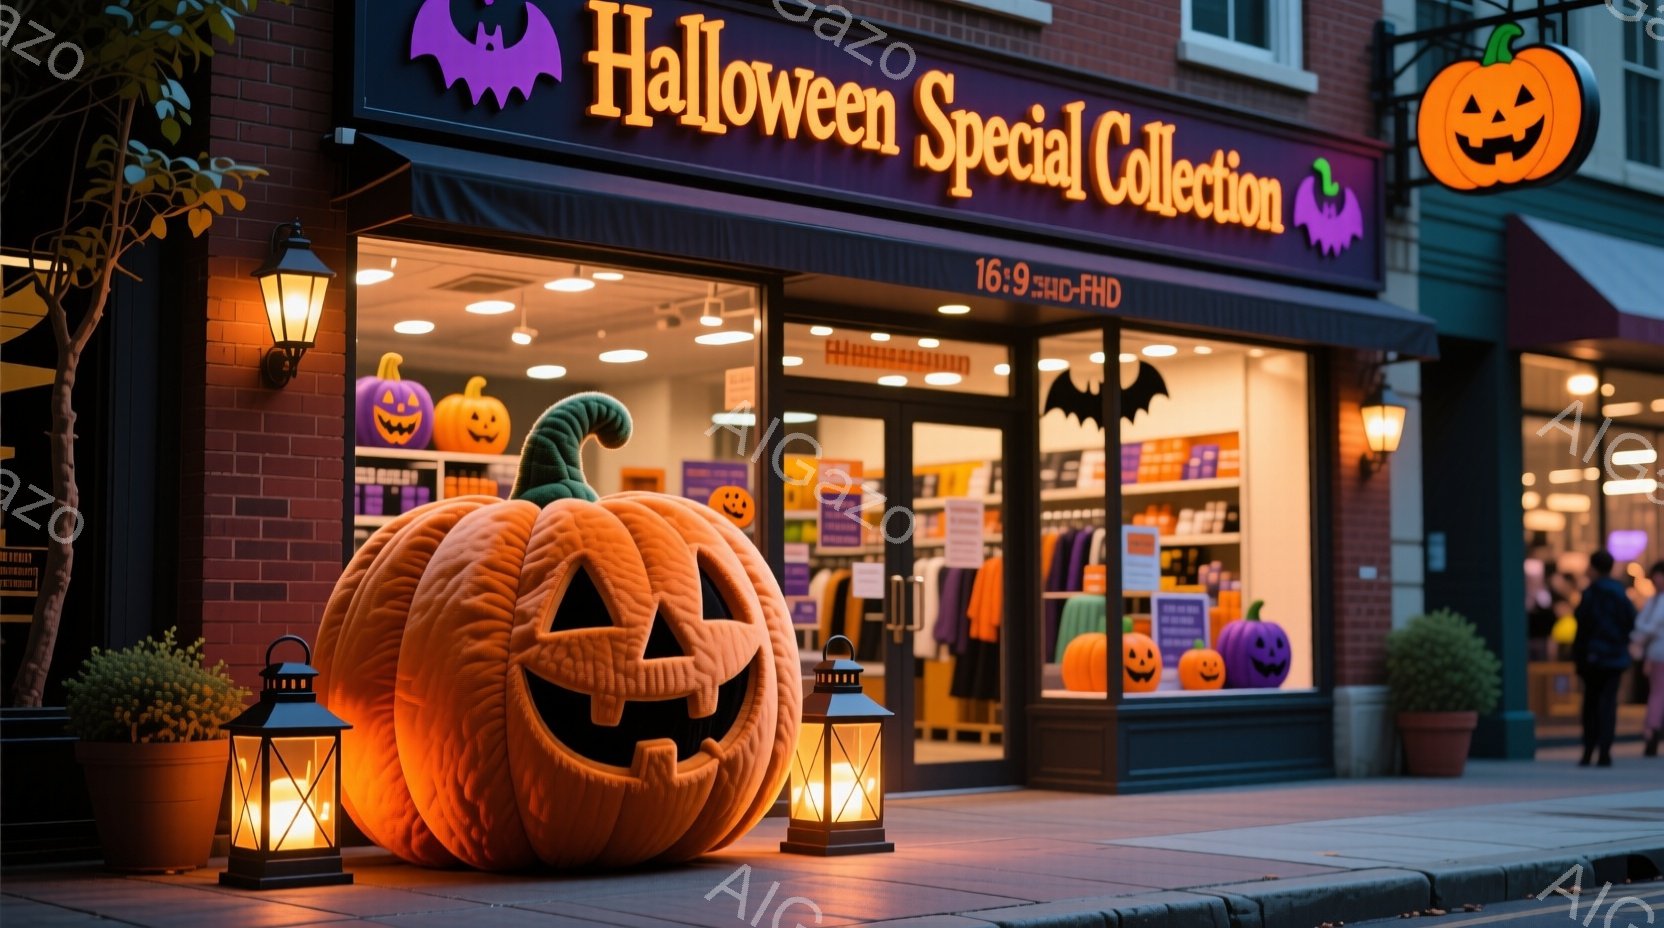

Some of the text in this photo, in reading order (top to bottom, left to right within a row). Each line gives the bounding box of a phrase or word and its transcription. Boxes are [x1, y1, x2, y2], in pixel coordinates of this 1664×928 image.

[585, 0, 1284, 234] Halloween Special Collection
[976, 258, 1030, 296] 16:9
